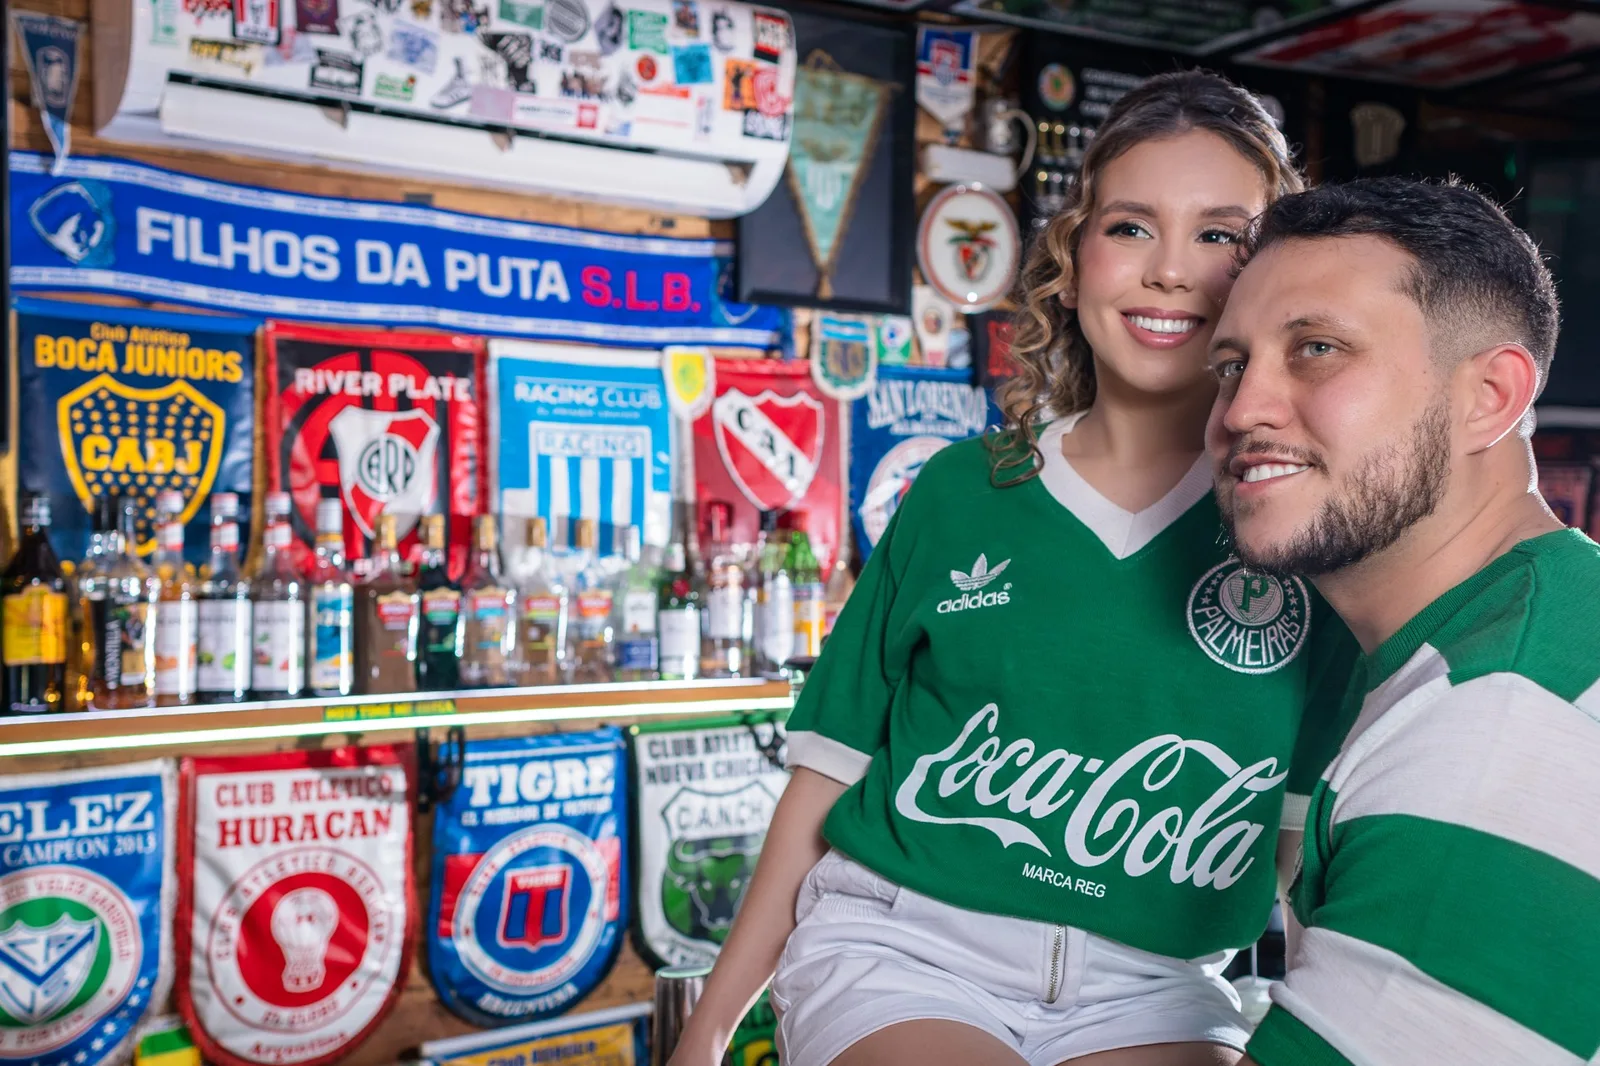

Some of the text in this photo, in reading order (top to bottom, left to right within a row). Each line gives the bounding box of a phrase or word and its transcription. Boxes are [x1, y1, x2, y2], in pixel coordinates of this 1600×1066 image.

[136, 206, 341, 282] FILHOS
[355, 239, 431, 288] DA
[444, 248, 570, 303] PUTA
[580, 265, 701, 312] S.L.B.
[34, 334, 244, 383] BOCA JUNIORS
[294, 368, 472, 402] RIVER PLATE
[514, 382, 662, 409] RACING CLUB
[80, 434, 203, 475] CABJ
[937, 590, 1010, 613] adidas
[1194, 605, 1301, 666] PALMEIRAS
[647, 738, 697, 759] CLUB
[216, 774, 393, 807] CLUB ATLETICO
[463, 753, 615, 808] TIGRE
[645, 761, 706, 784] NUEVA
[895, 702, 1290, 891] Coca-Cola
[217, 808, 392, 848] HURACAN
[3, 835, 109, 867] CAMPEON
[1022, 861, 1107, 899] MARCA REG
